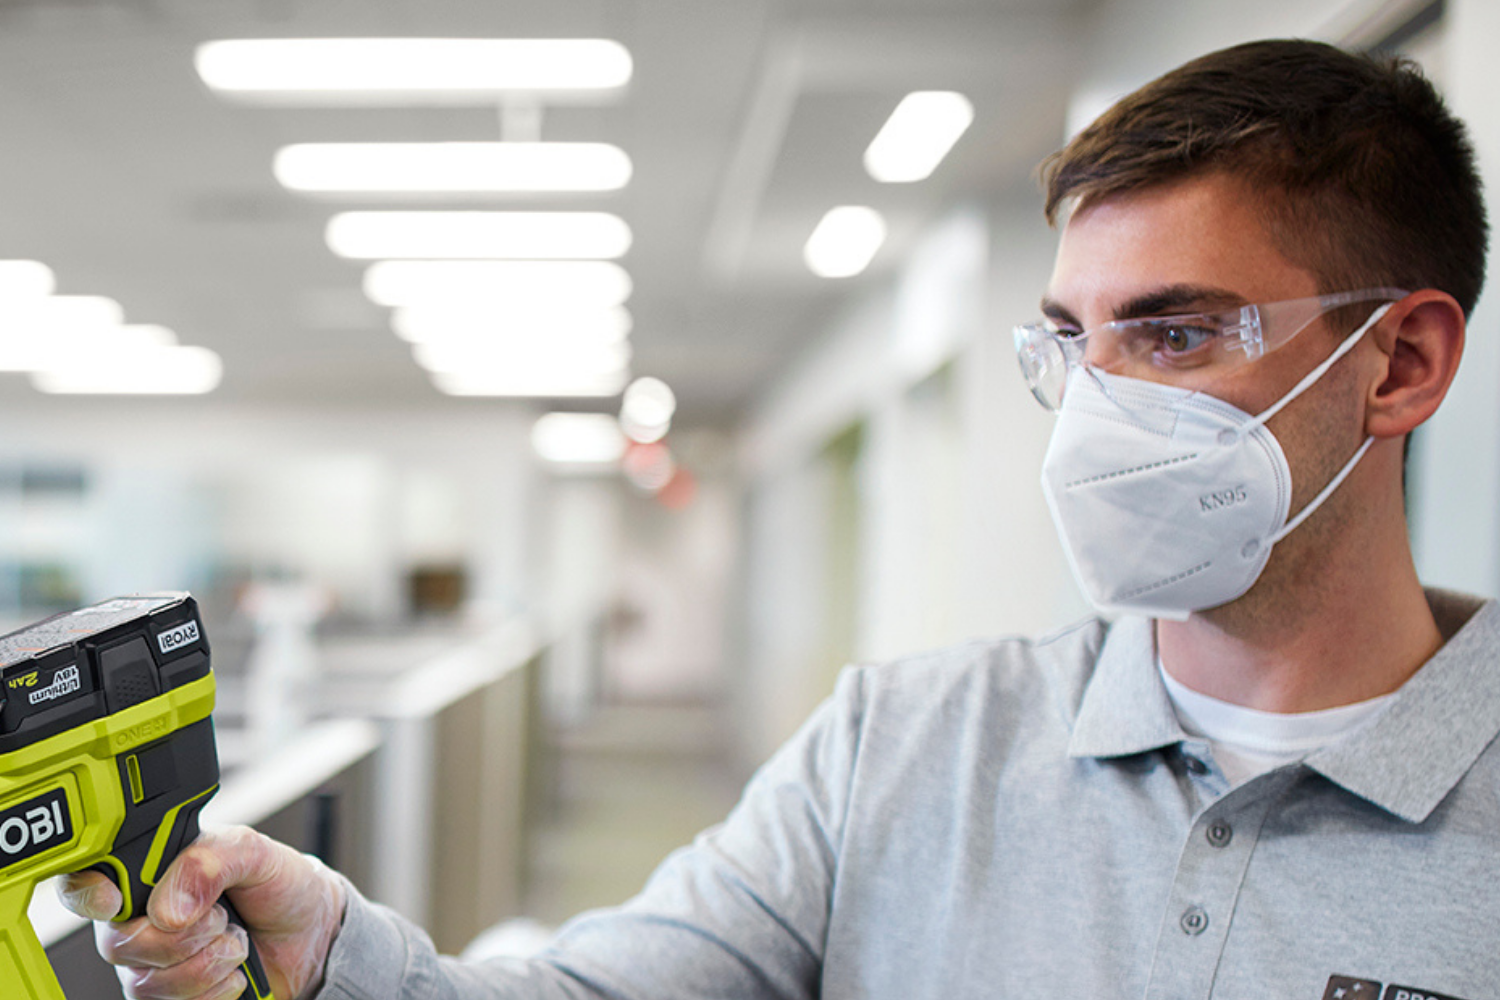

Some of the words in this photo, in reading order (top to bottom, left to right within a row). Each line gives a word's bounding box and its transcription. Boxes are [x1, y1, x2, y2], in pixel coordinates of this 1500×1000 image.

[1199, 484, 1247, 512] KN95
[161, 624, 197, 649] RYOBI
[55, 667, 77, 683] 18V
[31, 679, 78, 702] Lithium
